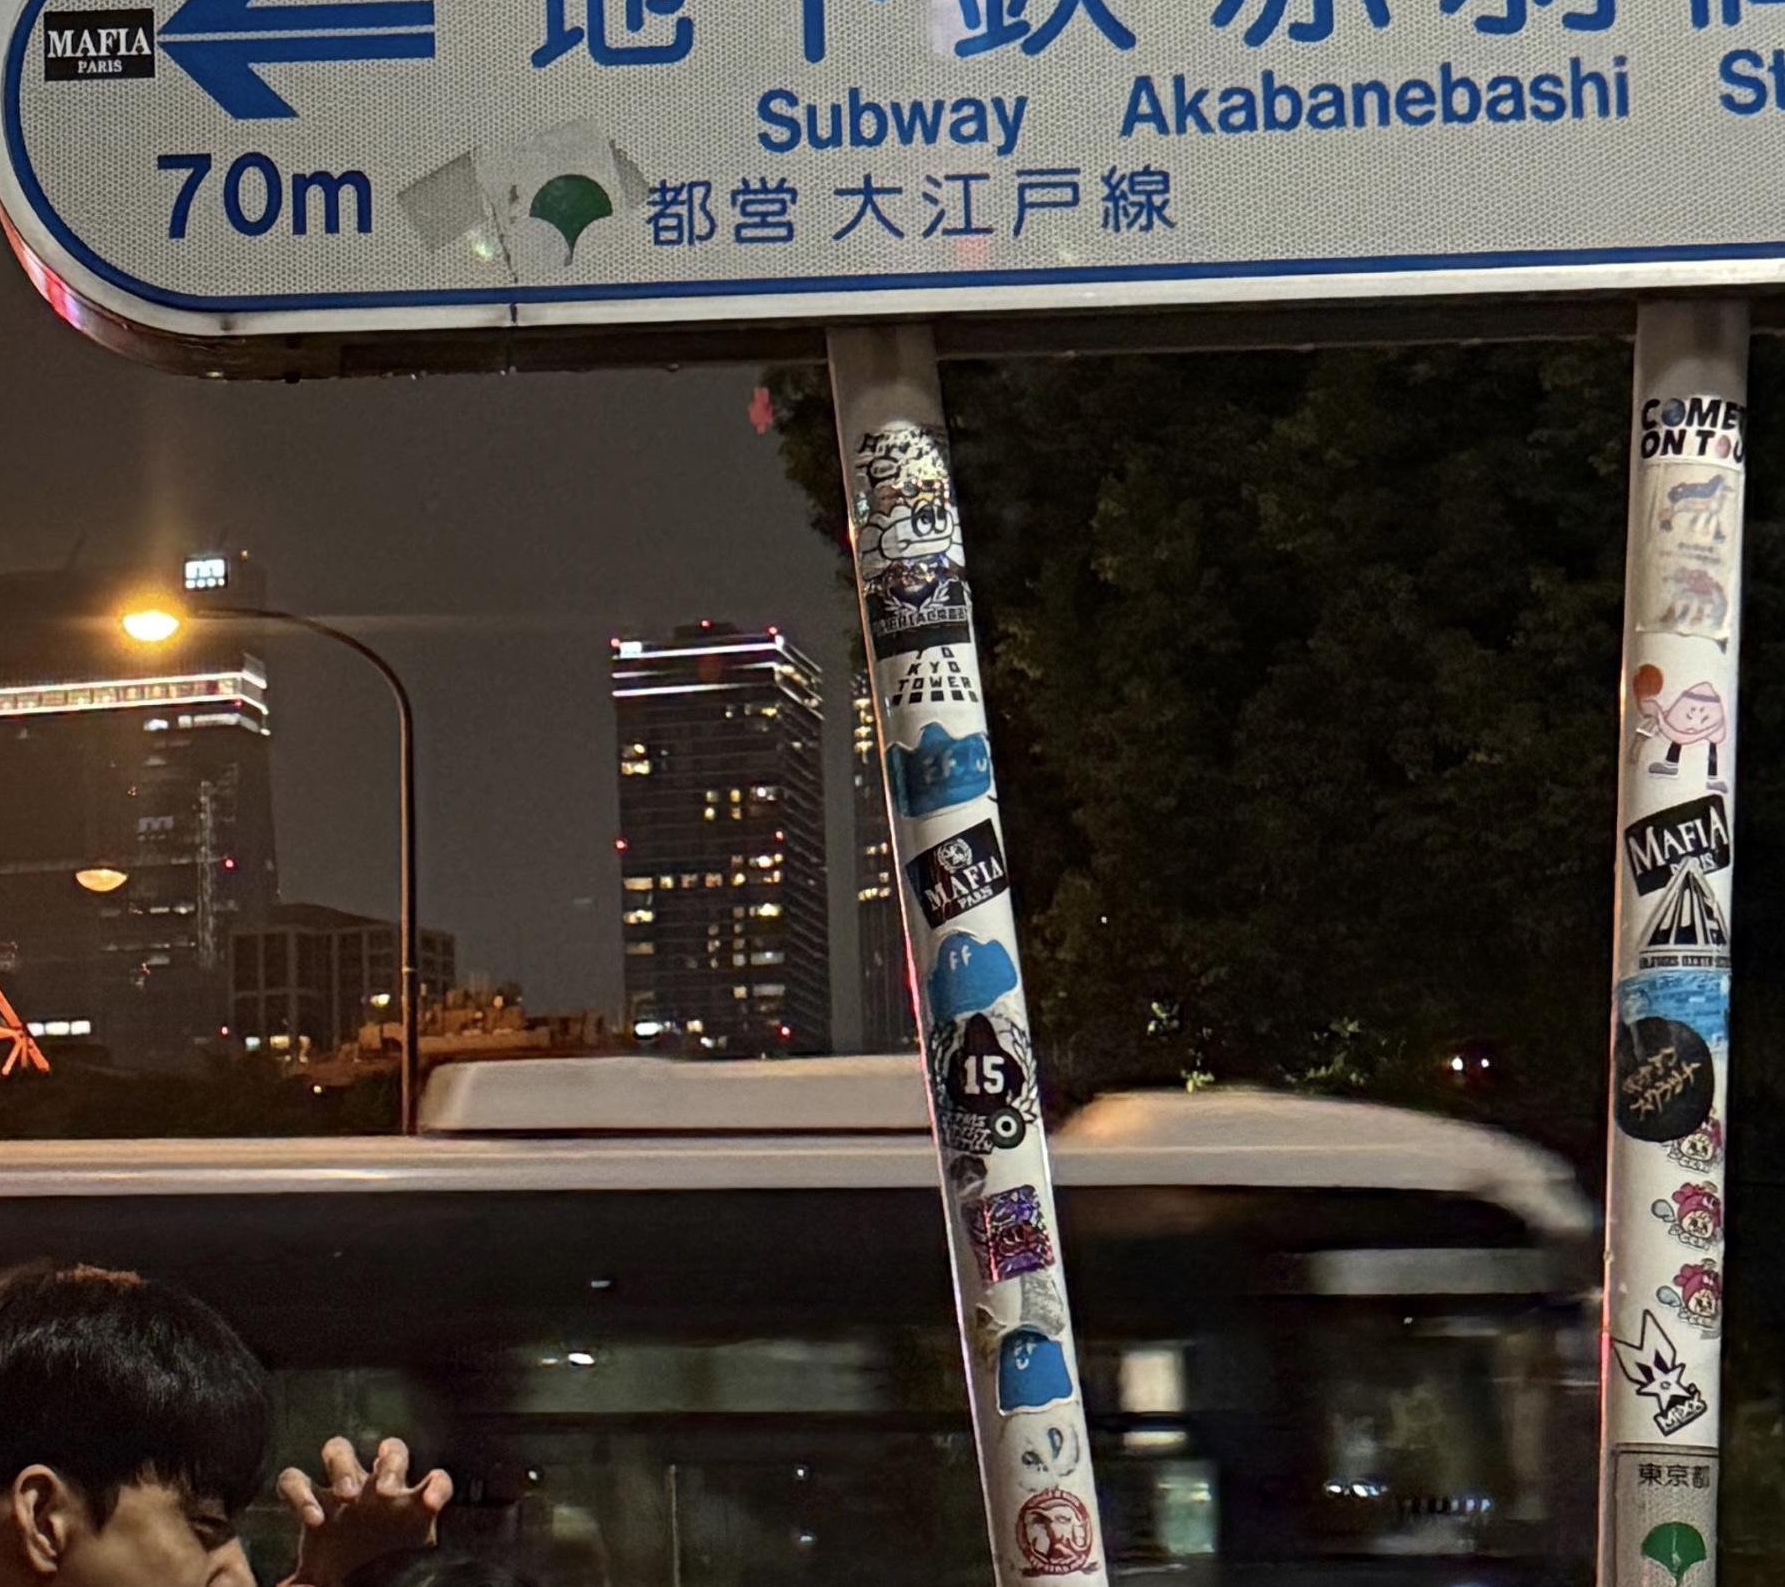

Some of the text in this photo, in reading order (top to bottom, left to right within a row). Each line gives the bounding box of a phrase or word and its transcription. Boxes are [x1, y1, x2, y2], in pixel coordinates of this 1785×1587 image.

[46, 26, 152, 60] MAFIA
[77, 59, 123, 75] PARIS
[757, 86, 1028, 157] Subway
[1119, 55, 1630, 138] Akabanebashi
[156, 151, 373, 239] 70m
[646, 163, 1178, 249] 都営 大江戸線
[1640, 428, 1688, 459] ON
[898, 675, 972, 693] TOWER
[1628, 804, 1729, 876] MAFIA
[924, 855, 1004, 912] MAFIA
[963, 1054, 1005, 1095] 15
[1637, 1463, 1711, 1490] 東京都
